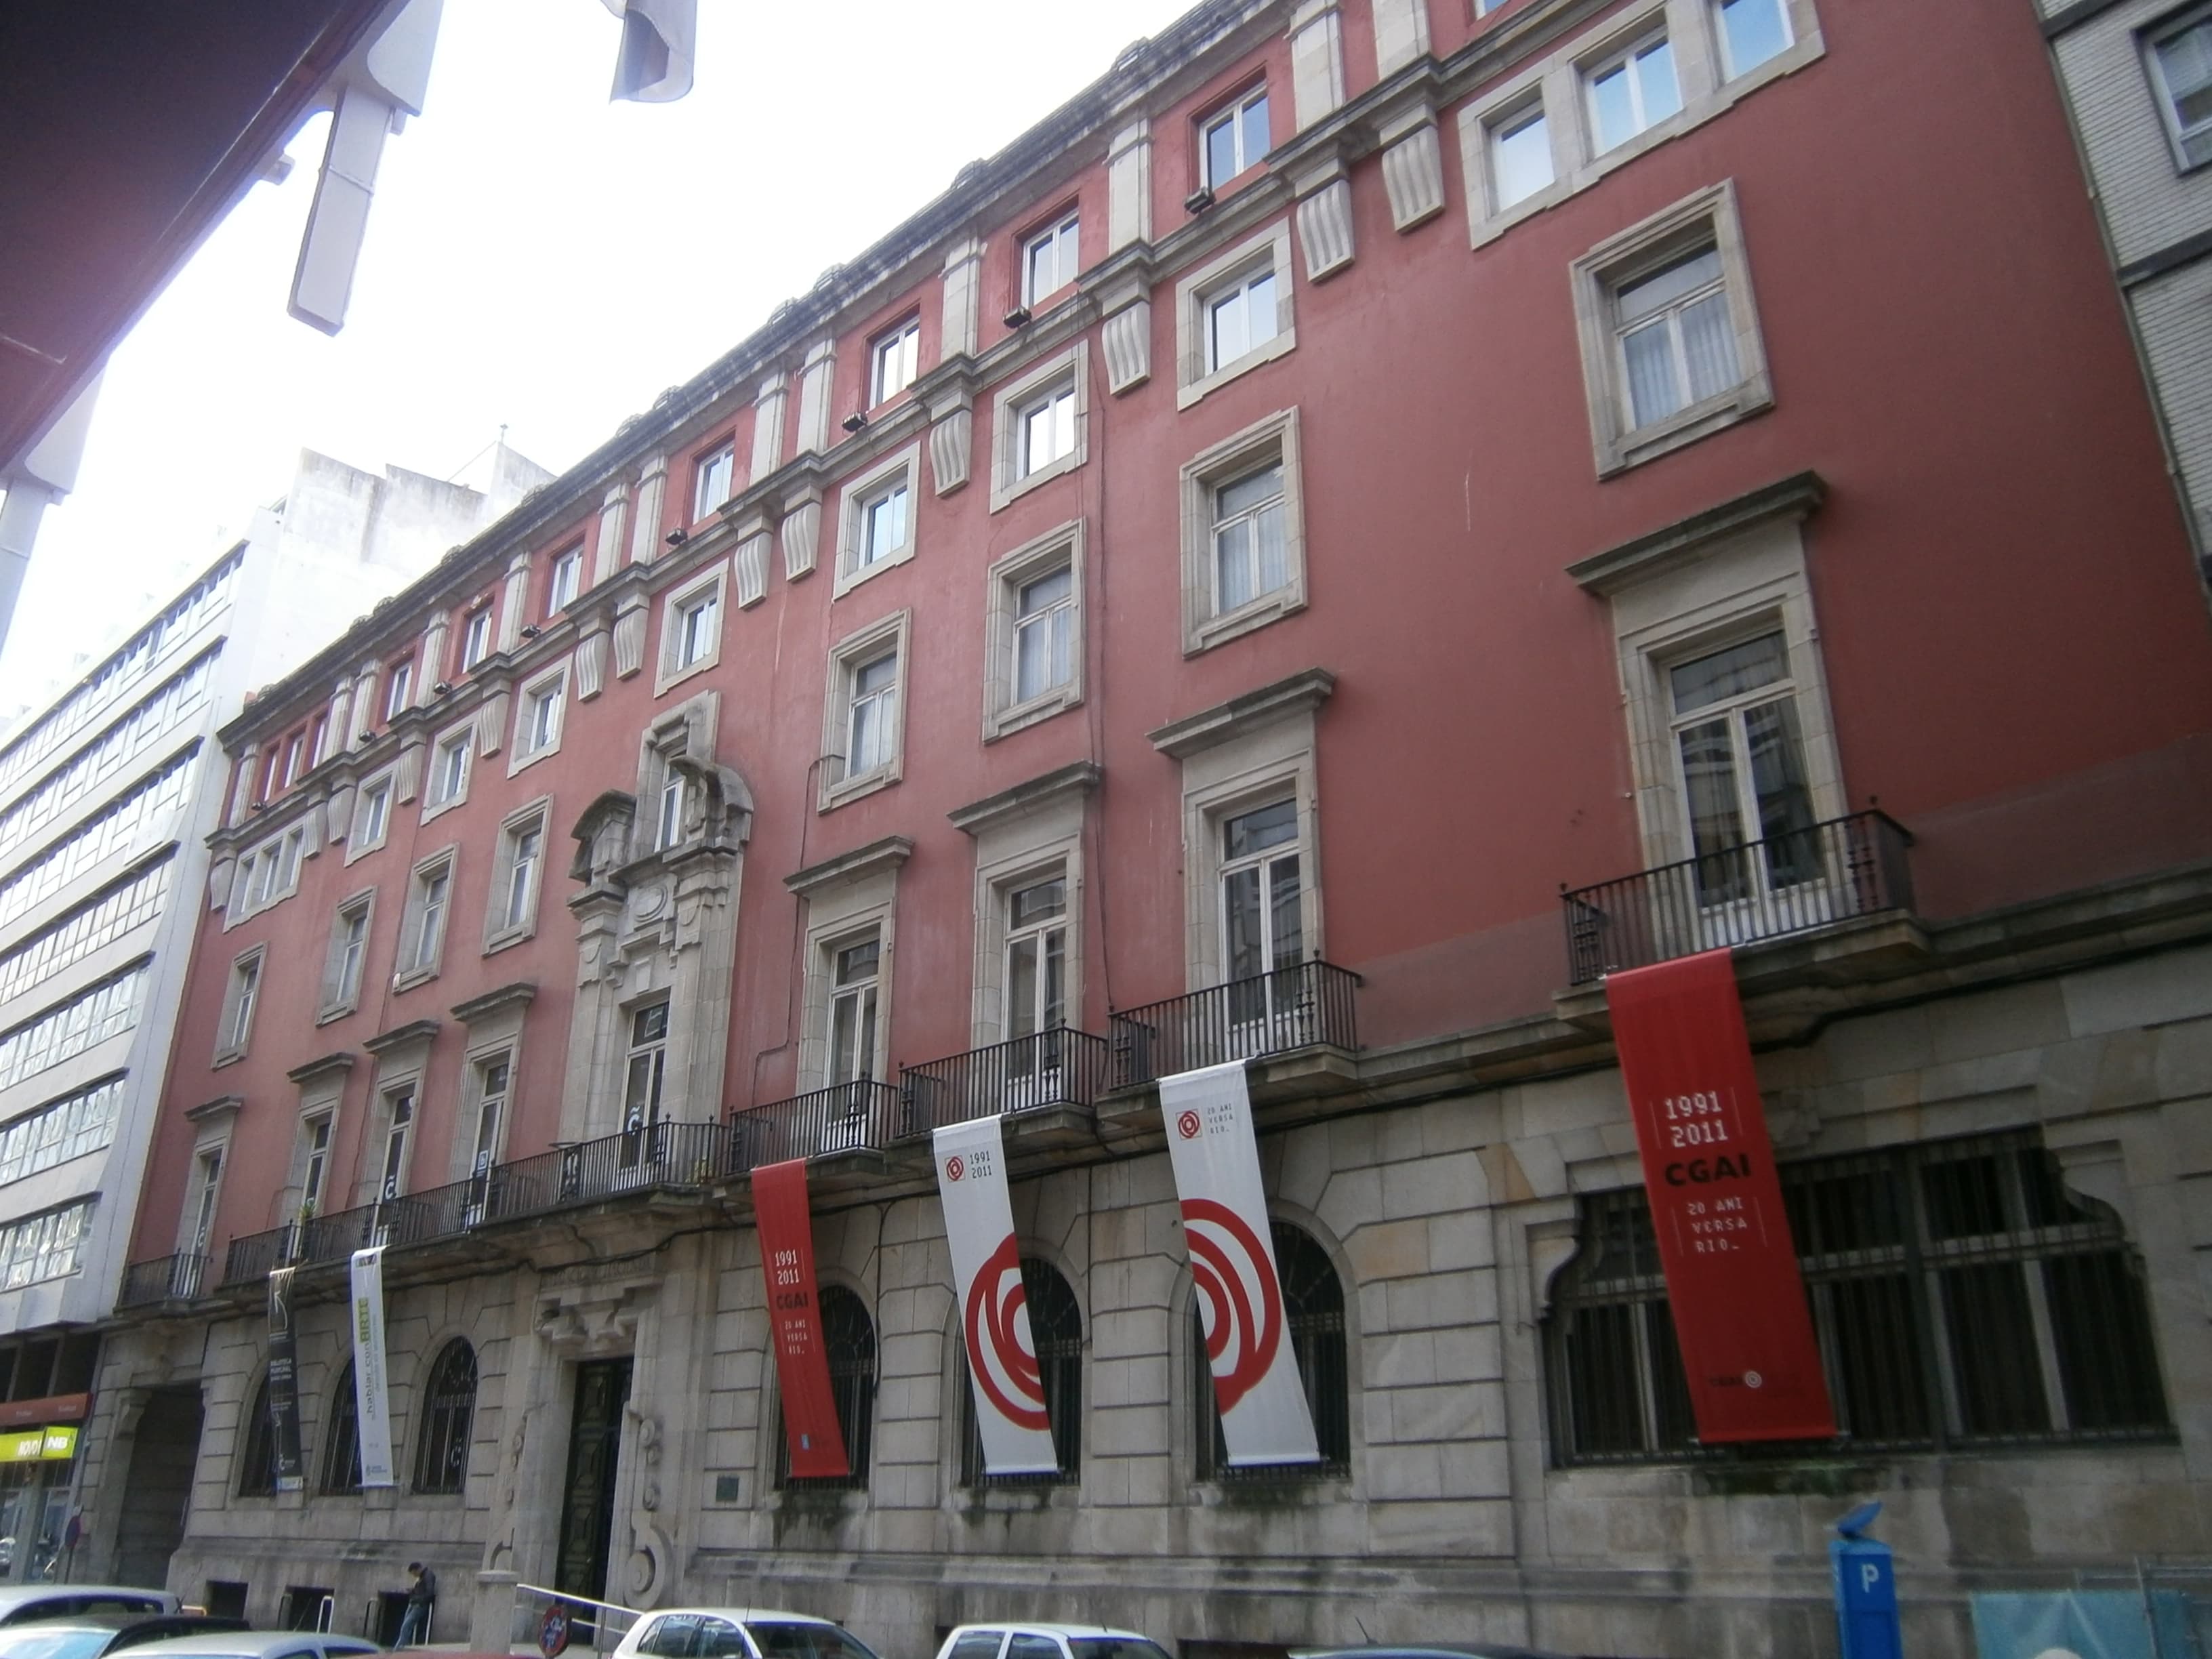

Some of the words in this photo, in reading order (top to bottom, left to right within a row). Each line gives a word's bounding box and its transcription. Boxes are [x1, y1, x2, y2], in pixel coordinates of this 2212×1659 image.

[1665, 1090, 1722, 1120] 1991
[1670, 1120, 1728, 1147] 2011
[970, 1150, 990, 1164] 1991
[971, 1165, 992, 1179] 2011
[1665, 1153, 1753, 1186] CGAI
[1687, 1202, 1706, 1215] 20
[1715, 1197, 1743, 1212] ANI
[1692, 1218, 1747, 1233] VERSA
[775, 1249, 797, 1267] 1991
[777, 1268, 799, 1285] 2011
[776, 1291, 808, 1309] CGAI
[787, 1332, 807, 1342] VERSA
[48, 1437, 68, 1449] NB
[1862, 1563, 1880, 1593] P
